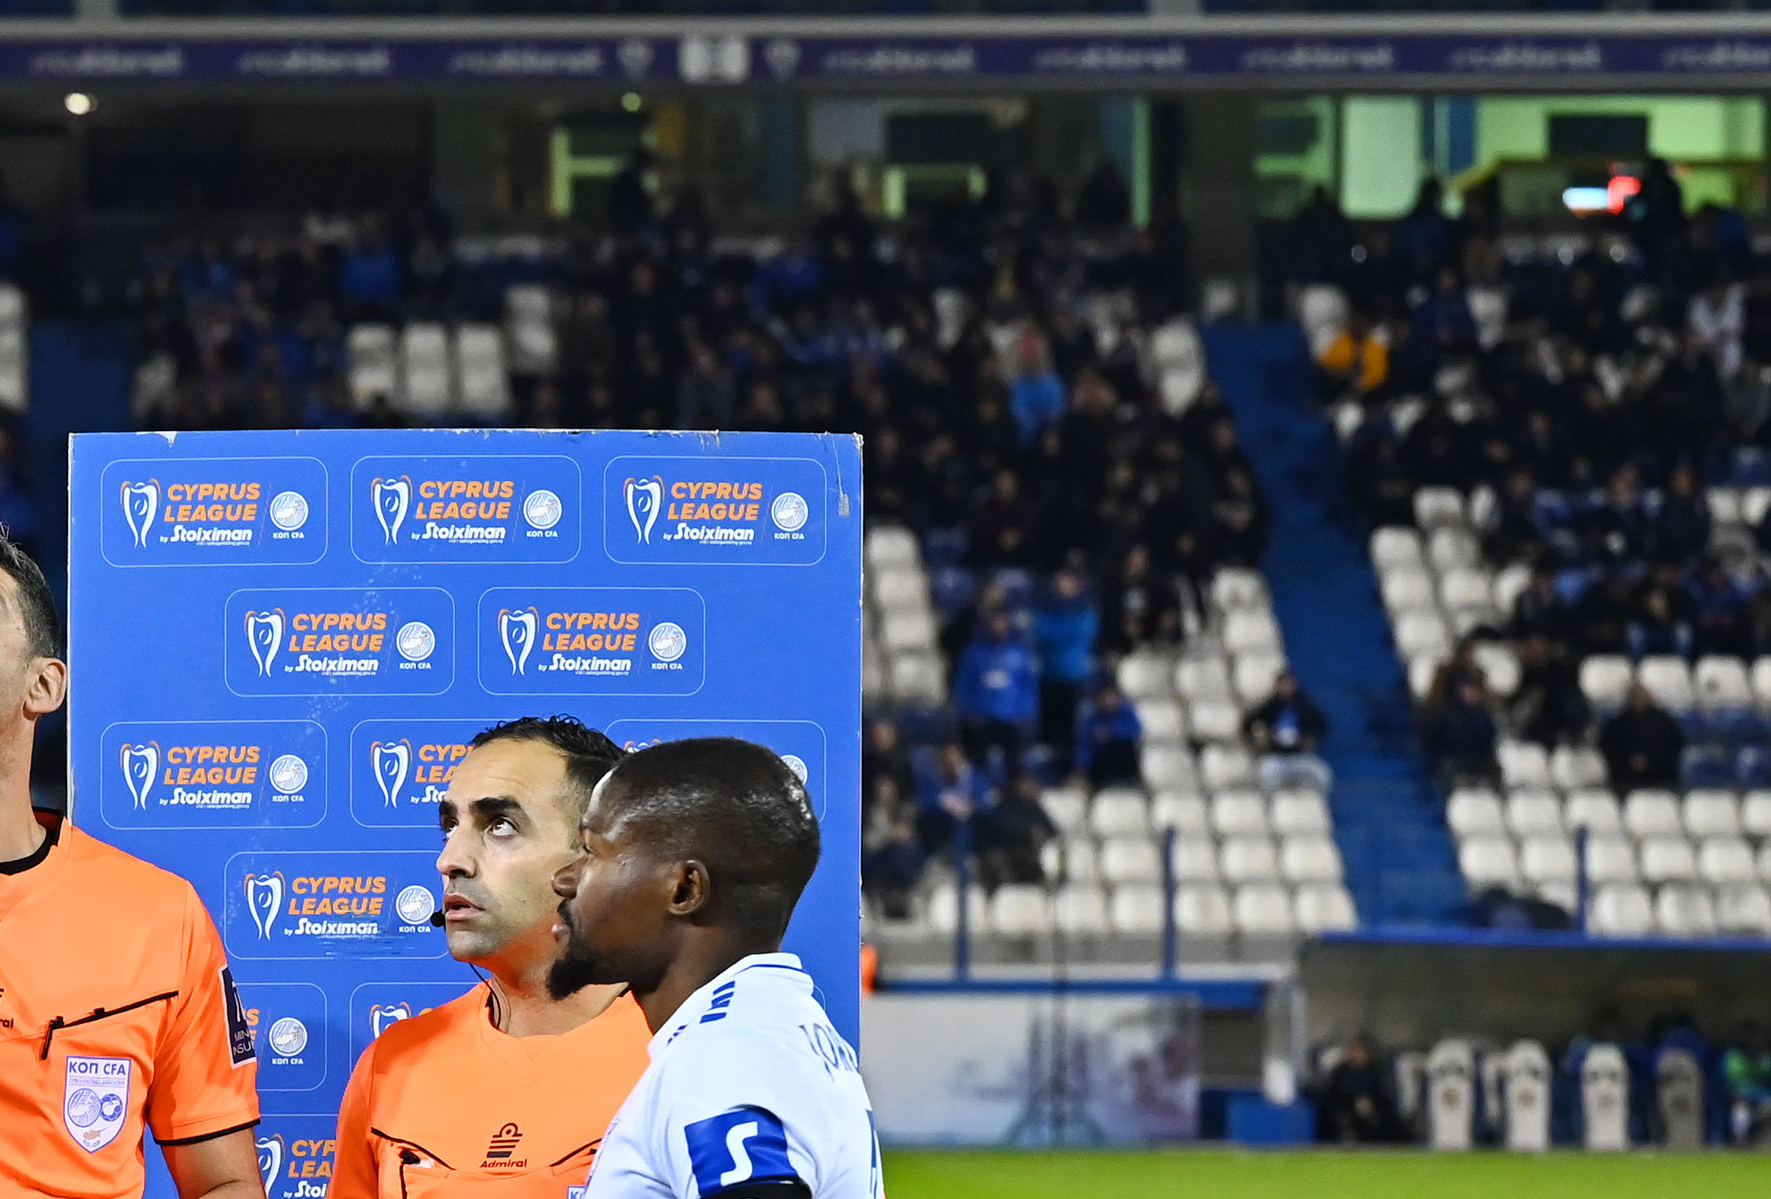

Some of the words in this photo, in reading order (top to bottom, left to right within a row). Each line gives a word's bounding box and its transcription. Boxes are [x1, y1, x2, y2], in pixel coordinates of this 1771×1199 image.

[169, 483, 260, 500] CYPRUS
[420, 481, 514, 498] CYPRUS
[672, 482, 762, 499] CYPRUS
[165, 504, 257, 522] LEAGUE
[417, 502, 511, 519] LEAGUE
[669, 503, 759, 520] LEAGUE
[170, 525, 253, 543] Stoiximan
[422, 522, 506, 540] Stoiximan
[673, 523, 755, 541] Stoiximan
[294, 614, 387, 630] CYPRUS
[547, 613, 639, 629] CYPRUS
[290, 634, 384, 651] LEAGUE
[544, 634, 636, 650] LEAGUE
[295, 655, 379, 673] Stoiximan
[548, 654, 632, 672] Stoiximan
[169, 746, 260, 763] CYPRUS
[165, 767, 257, 784] LEAGUE
[169, 788, 252, 806] Stoiximan
[293, 877, 386, 894] CYPRUS
[289, 898, 383, 914] LEAGUE
[294, 918, 378, 936] Stoiximan
[103, 1063, 126, 1076] CFA
[479, 1158, 527, 1168] Admiral
